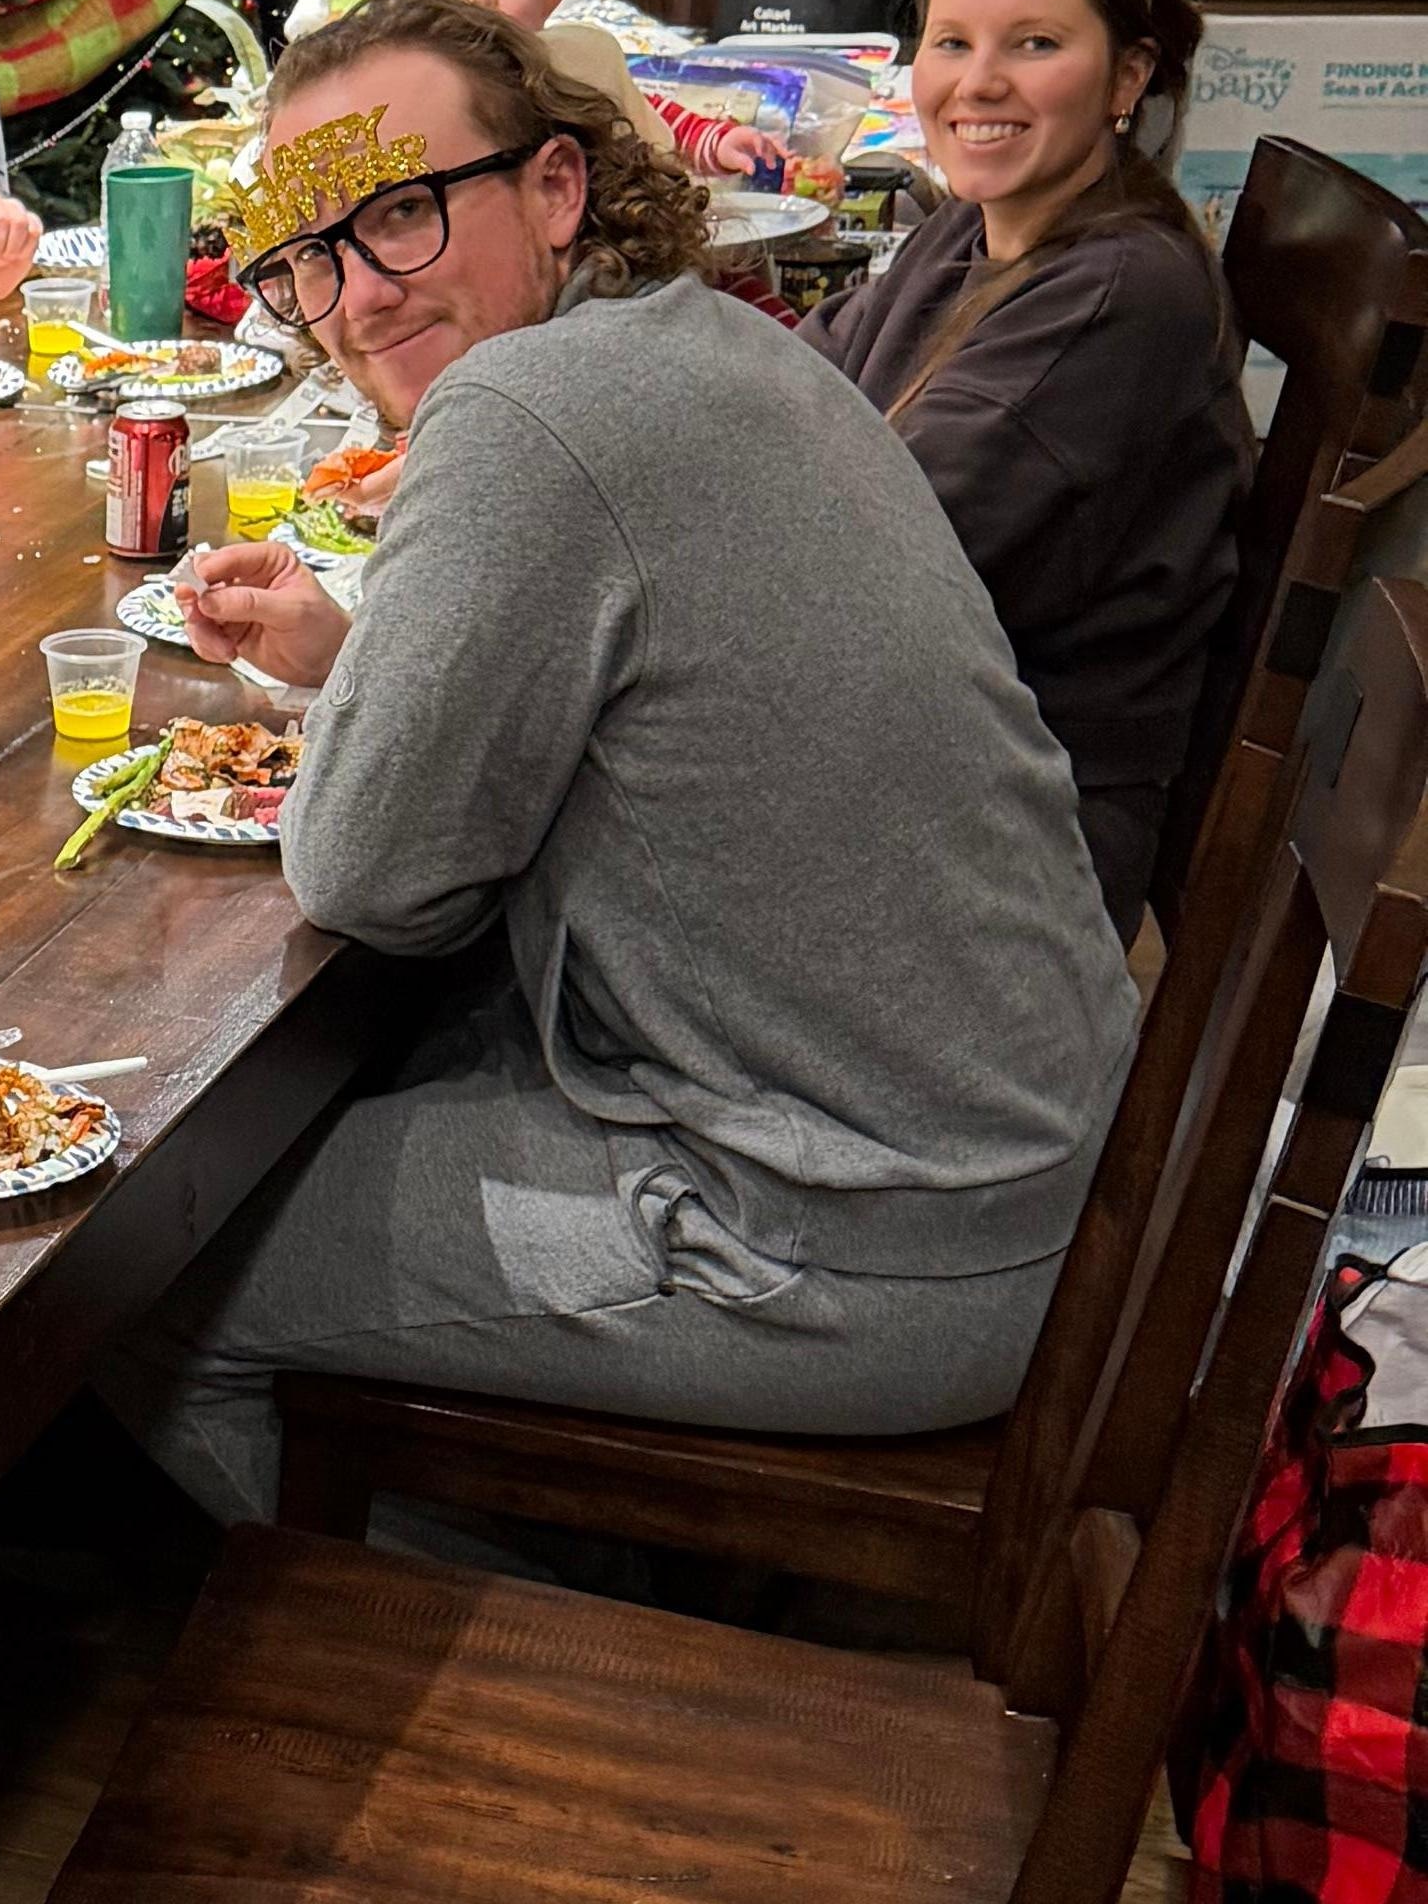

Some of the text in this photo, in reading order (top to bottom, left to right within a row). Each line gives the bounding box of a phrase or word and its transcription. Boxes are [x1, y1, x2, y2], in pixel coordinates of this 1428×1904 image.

[1324, 62, 1413, 79] FINDING
[1193, 72, 1290, 112] baby
[227, 102, 390, 214] HAPPY
